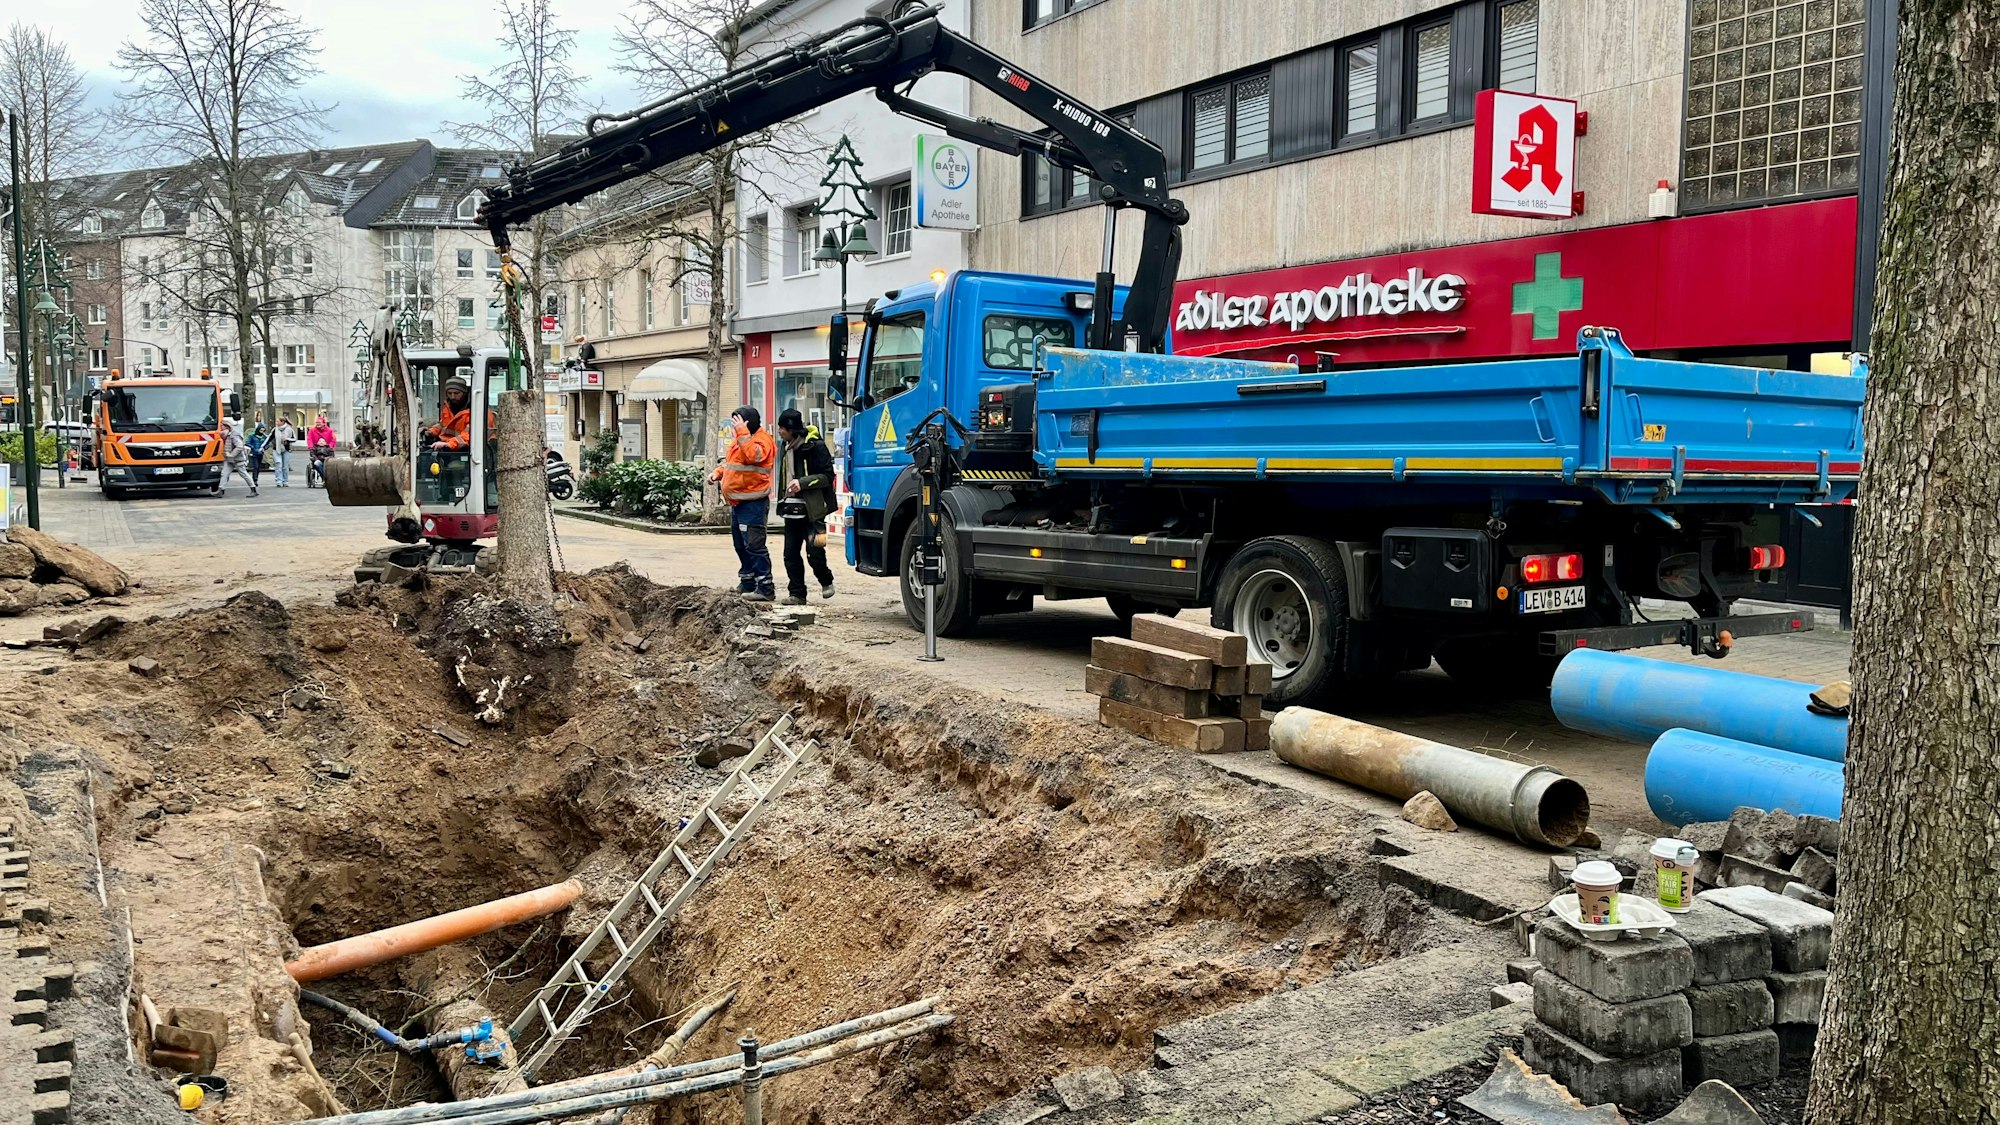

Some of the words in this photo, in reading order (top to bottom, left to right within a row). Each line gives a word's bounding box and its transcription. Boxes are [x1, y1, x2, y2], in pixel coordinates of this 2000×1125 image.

[1008, 72, 1031, 92] HIAB
[1052, 98, 1093, 127] X-HIDUO
[1092, 120, 1111, 138] 108
[935, 162, 967, 173] BAYER
[947, 148, 955, 187] BAYER
[940, 198, 963, 209] Adler
[1517, 199, 1530, 208] seit
[1531, 199, 1548, 209] 1885
[931, 209, 970, 221] Apotheke
[751, 345, 760, 358] 27
[861, 493, 871, 507] 29
[1525, 590, 1547, 610] LEV
[1554, 590, 1562, 607] B
[1563, 588, 1584, 606] 414
[1661, 880, 1678, 889] FAIR
